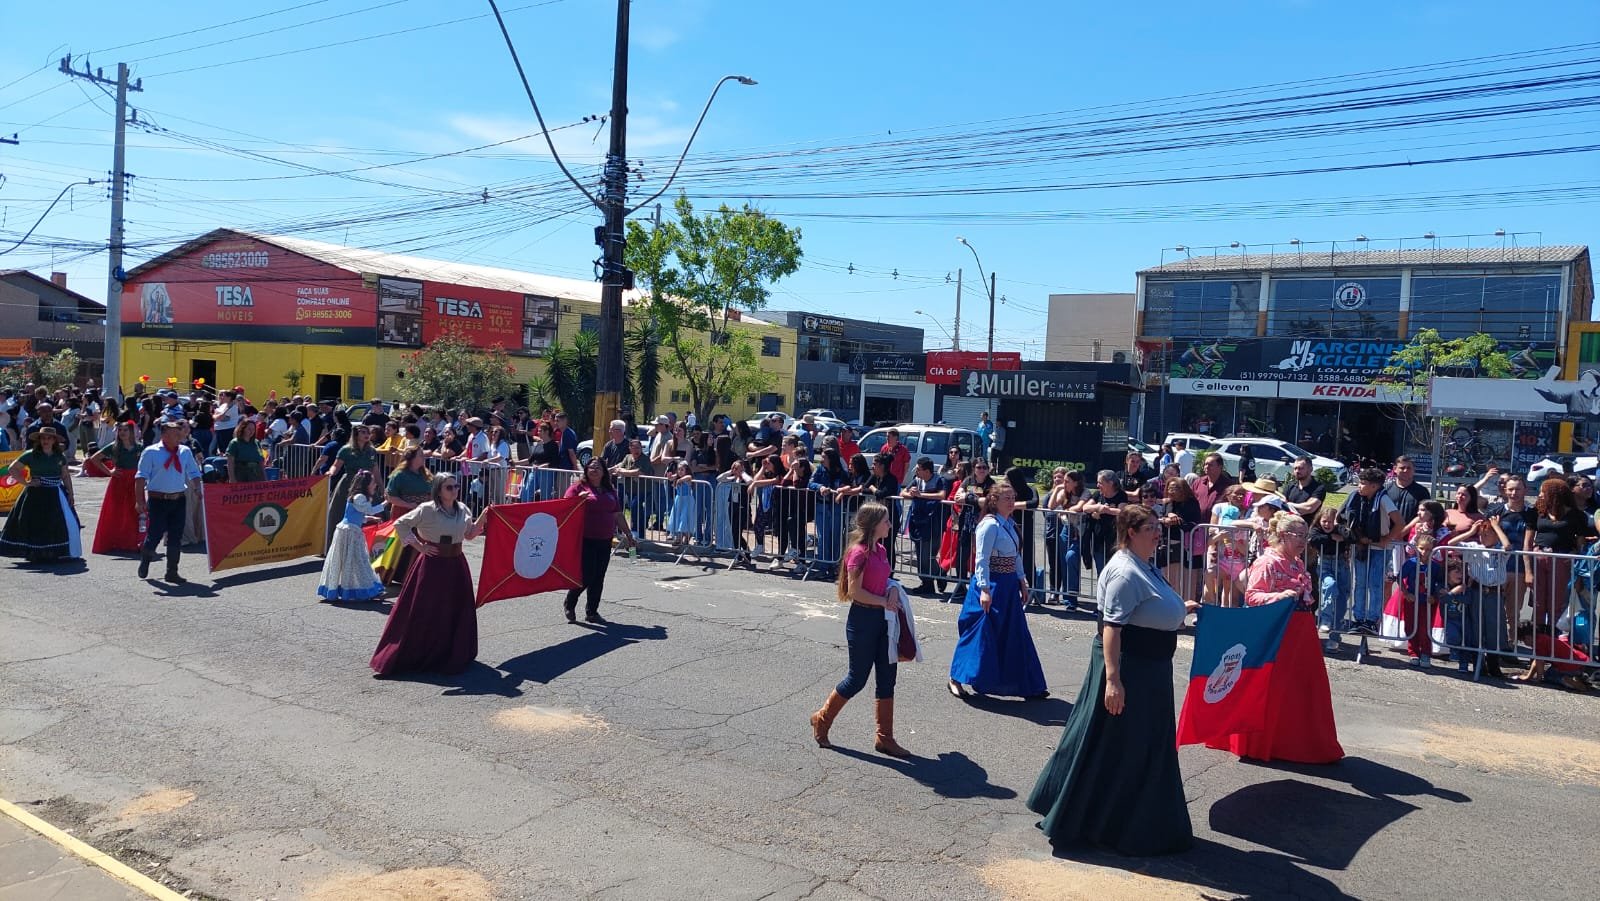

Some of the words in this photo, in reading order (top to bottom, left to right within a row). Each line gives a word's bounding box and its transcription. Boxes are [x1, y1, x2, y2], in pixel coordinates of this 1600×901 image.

[215, 286, 254, 306] TESA
[326, 297, 350, 306] ONLINE
[435, 297, 483, 318] TESA
[929, 367, 944, 376] CIA
[946, 367, 958, 376] do
[1239, 371, 1256, 380] (51)
[981, 373, 1050, 396] Muller
[1049, 382, 1095, 390] CHAVES
[1206, 383, 1250, 392] elleven
[1312, 385, 1377, 398] KENDA
[222, 493, 266, 505] PIQUETE
